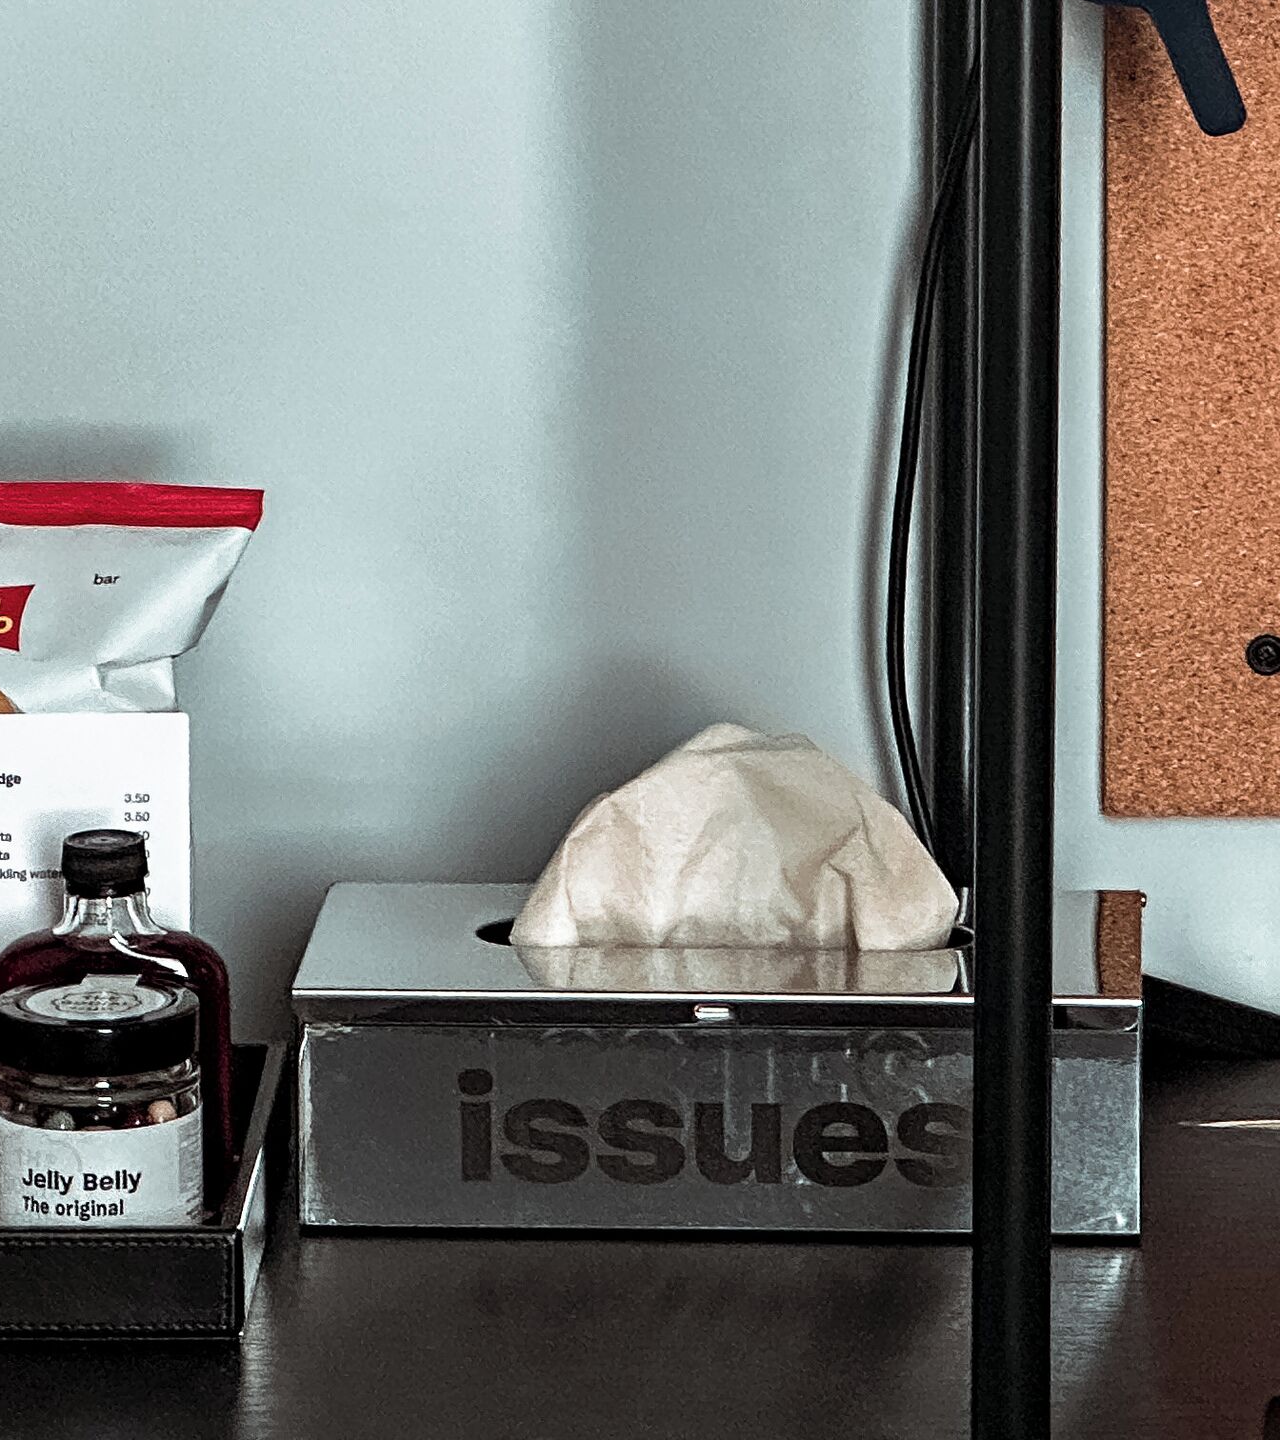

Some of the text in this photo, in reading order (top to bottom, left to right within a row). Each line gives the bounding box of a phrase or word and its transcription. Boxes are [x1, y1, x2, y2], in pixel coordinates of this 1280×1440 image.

[93, 573, 120, 586] bar
[124, 793, 150, 804] 3.50
[124, 811, 150, 822] 3.50
[457, 1067, 974, 1188] issues
[22, 1168, 142, 1195] Jelly Belly
[23, 1196, 125, 1221] The original
